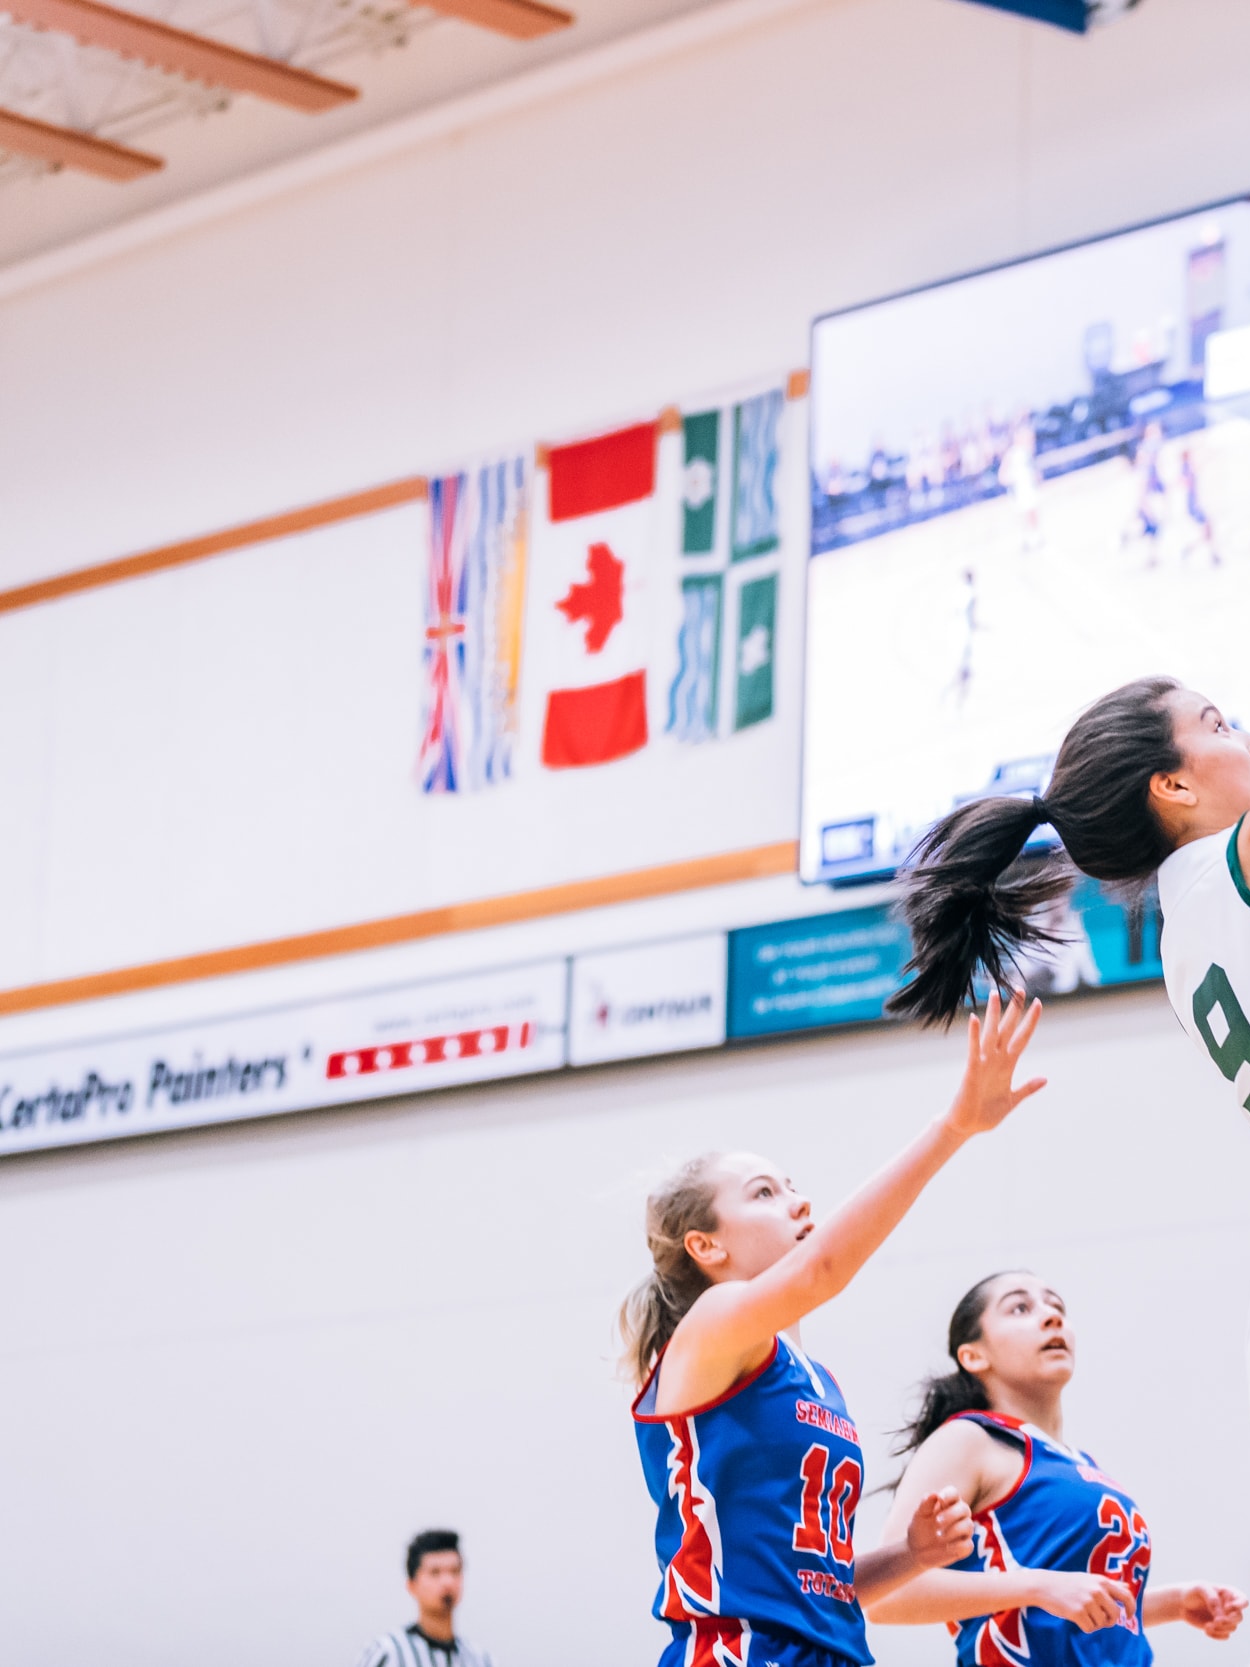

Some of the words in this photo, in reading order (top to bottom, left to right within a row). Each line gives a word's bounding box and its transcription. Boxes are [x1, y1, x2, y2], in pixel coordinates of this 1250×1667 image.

[147, 1049, 287, 1107] Painters
[796, 1399, 861, 1448] SEMIAHM
[792, 1442, 861, 1569] 10
[1087, 1493, 1151, 1602] 22
